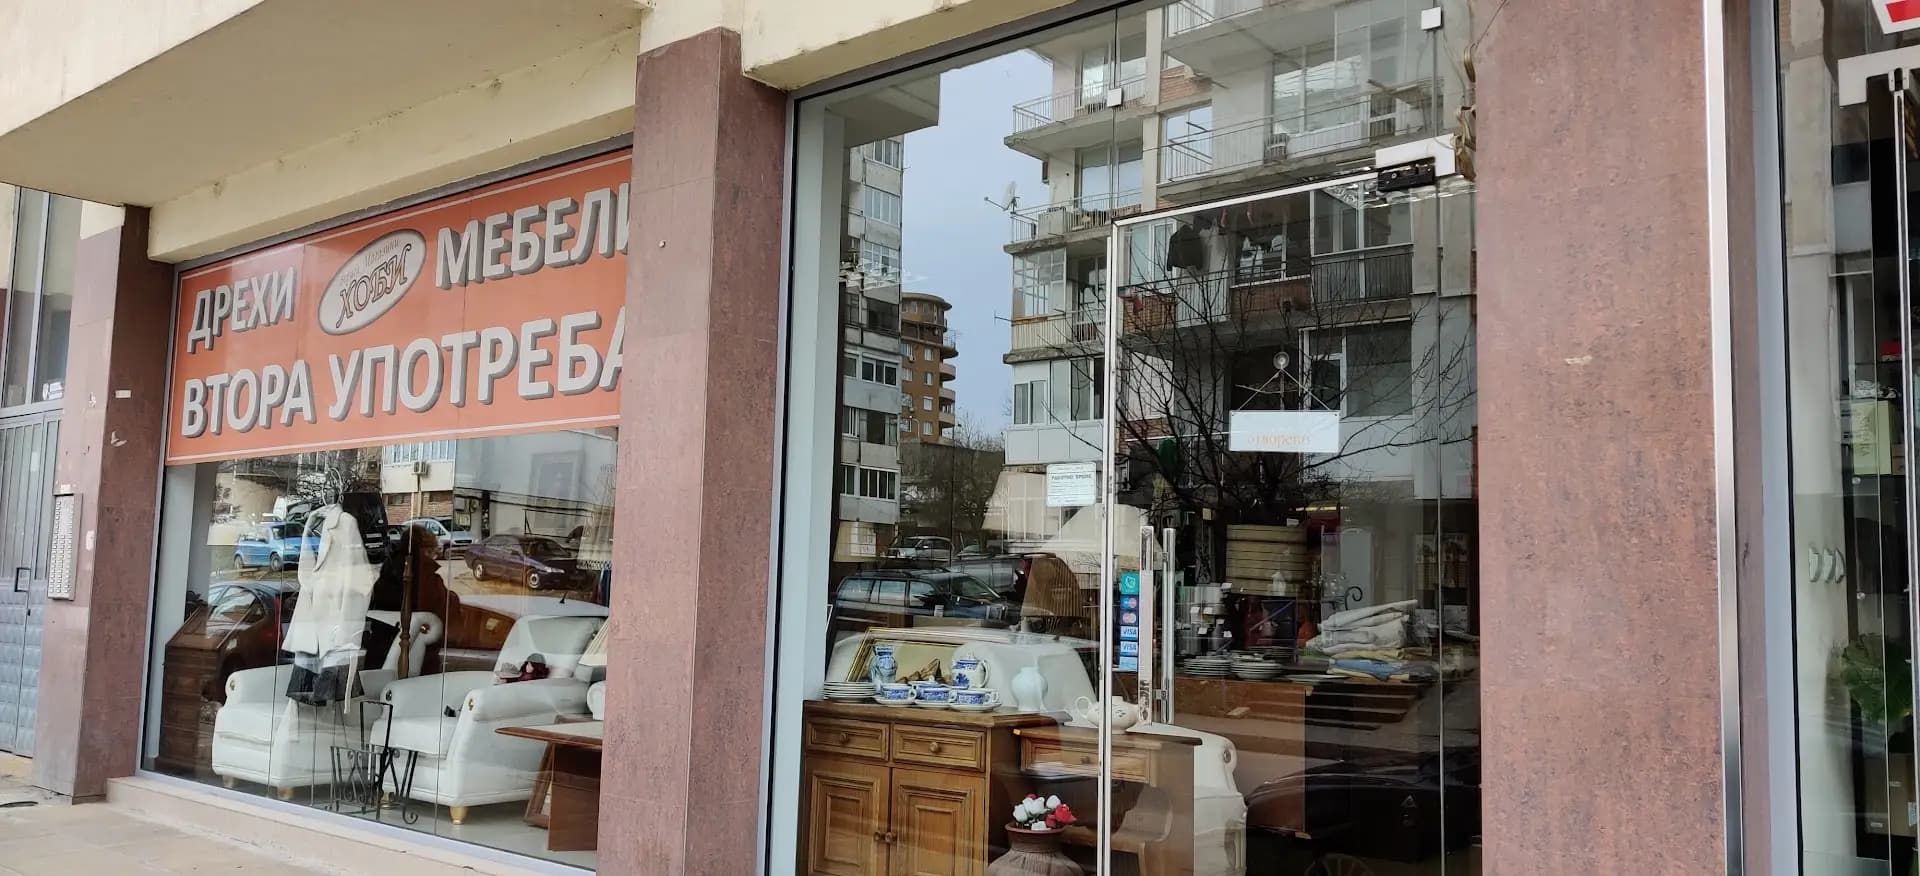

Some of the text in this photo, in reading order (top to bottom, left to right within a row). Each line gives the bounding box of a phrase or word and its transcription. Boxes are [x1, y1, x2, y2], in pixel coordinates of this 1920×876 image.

[187, 267, 295, 354] ДРЕХИ
[336, 243, 412, 328] ХОБИ
[181, 359, 317, 438] ВТОРА
